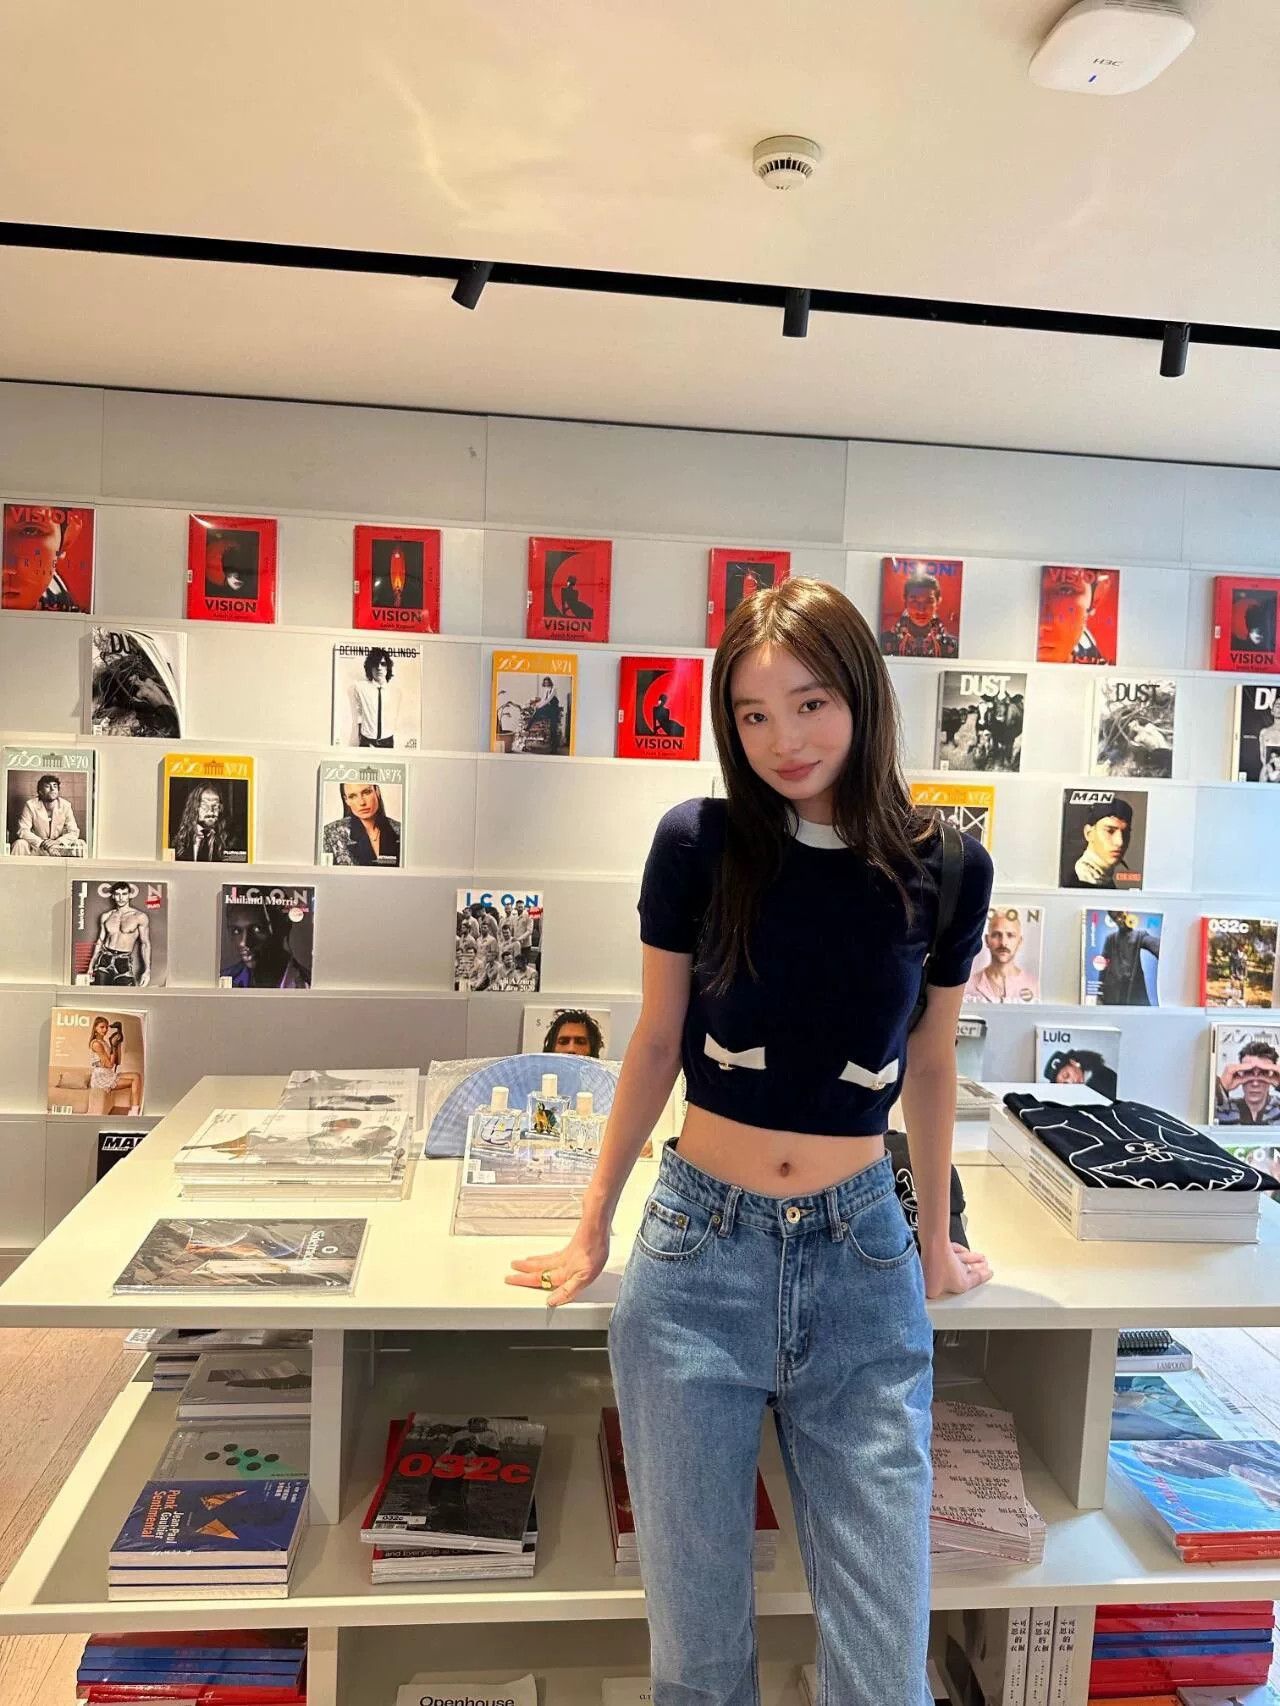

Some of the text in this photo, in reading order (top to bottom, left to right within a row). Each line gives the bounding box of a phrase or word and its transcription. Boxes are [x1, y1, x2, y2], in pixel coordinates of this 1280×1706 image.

[1093, 57, 1121, 67] H3C
[11, 507, 83, 528] VISION
[892, 561, 955, 576] VISON
[205, 599, 256, 613] VISION
[373, 609, 422, 622] VISION
[544, 620, 592, 633] VISION
[339, 645, 370, 657] BEHIND
[387, 647, 417, 658] BLINDS
[1231, 653, 1274, 664] VISION
[960, 674, 1011, 700] DUST
[1115, 682, 1160, 702] DUST
[635, 738, 683, 750] VISION
[1072, 792, 1112, 802] MAN
[231, 886, 308, 905] ICON
[265, 895, 298, 906] Morris
[466, 892, 539, 908] ICON
[1208, 919, 1249, 934] 032c
[56, 1012, 91, 1028] Lula
[957, 1025, 977, 1035] er
[1043, 1030, 1071, 1043] Lula
[398, 1453, 531, 1483] 032c
[164, 1489, 181, 1510] Punk
[141, 1490, 163, 1538] Sentimental
[155, 1511, 172, 1539] Gaultier
[419, 1696, 515, 1706] Openhouse
